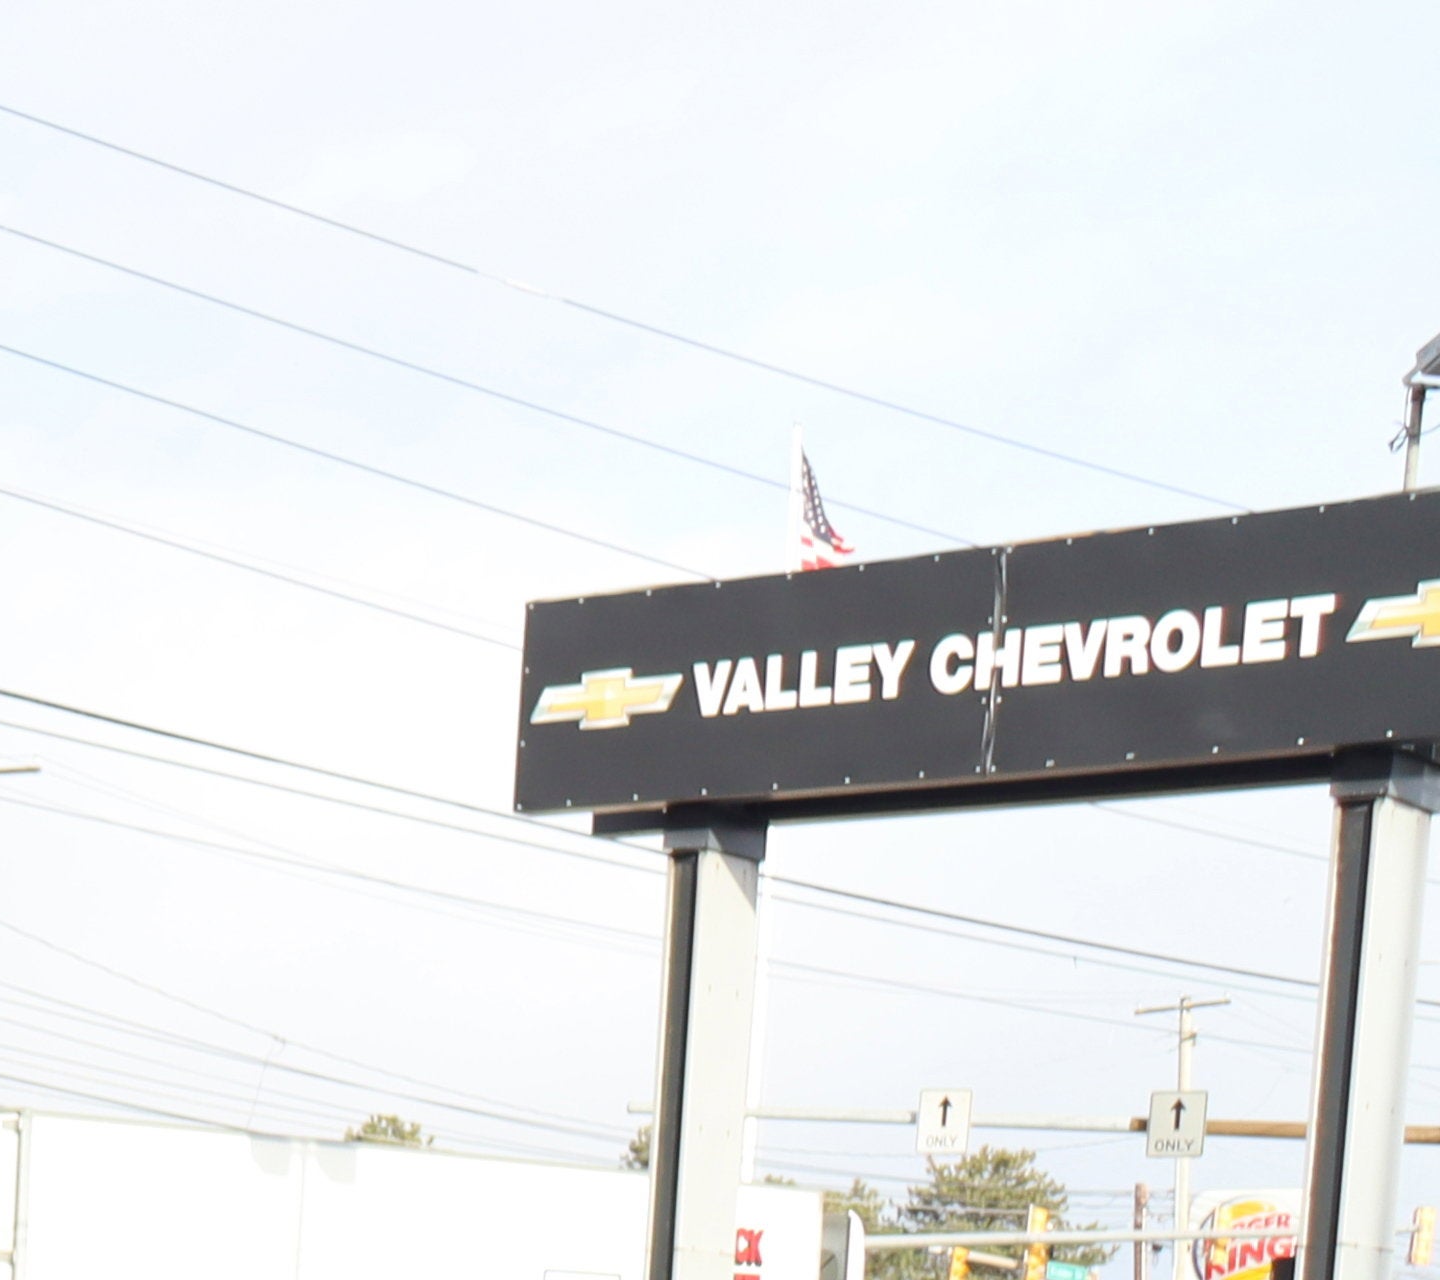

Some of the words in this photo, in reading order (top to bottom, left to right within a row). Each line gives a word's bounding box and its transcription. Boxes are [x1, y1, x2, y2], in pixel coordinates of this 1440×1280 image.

[692, 640, 916, 718] VALLEY
[929, 594, 1336, 695] CHEVROLET
[926, 1134, 958, 1148] ONLY
[1154, 1139, 1194, 1152] ONLY
